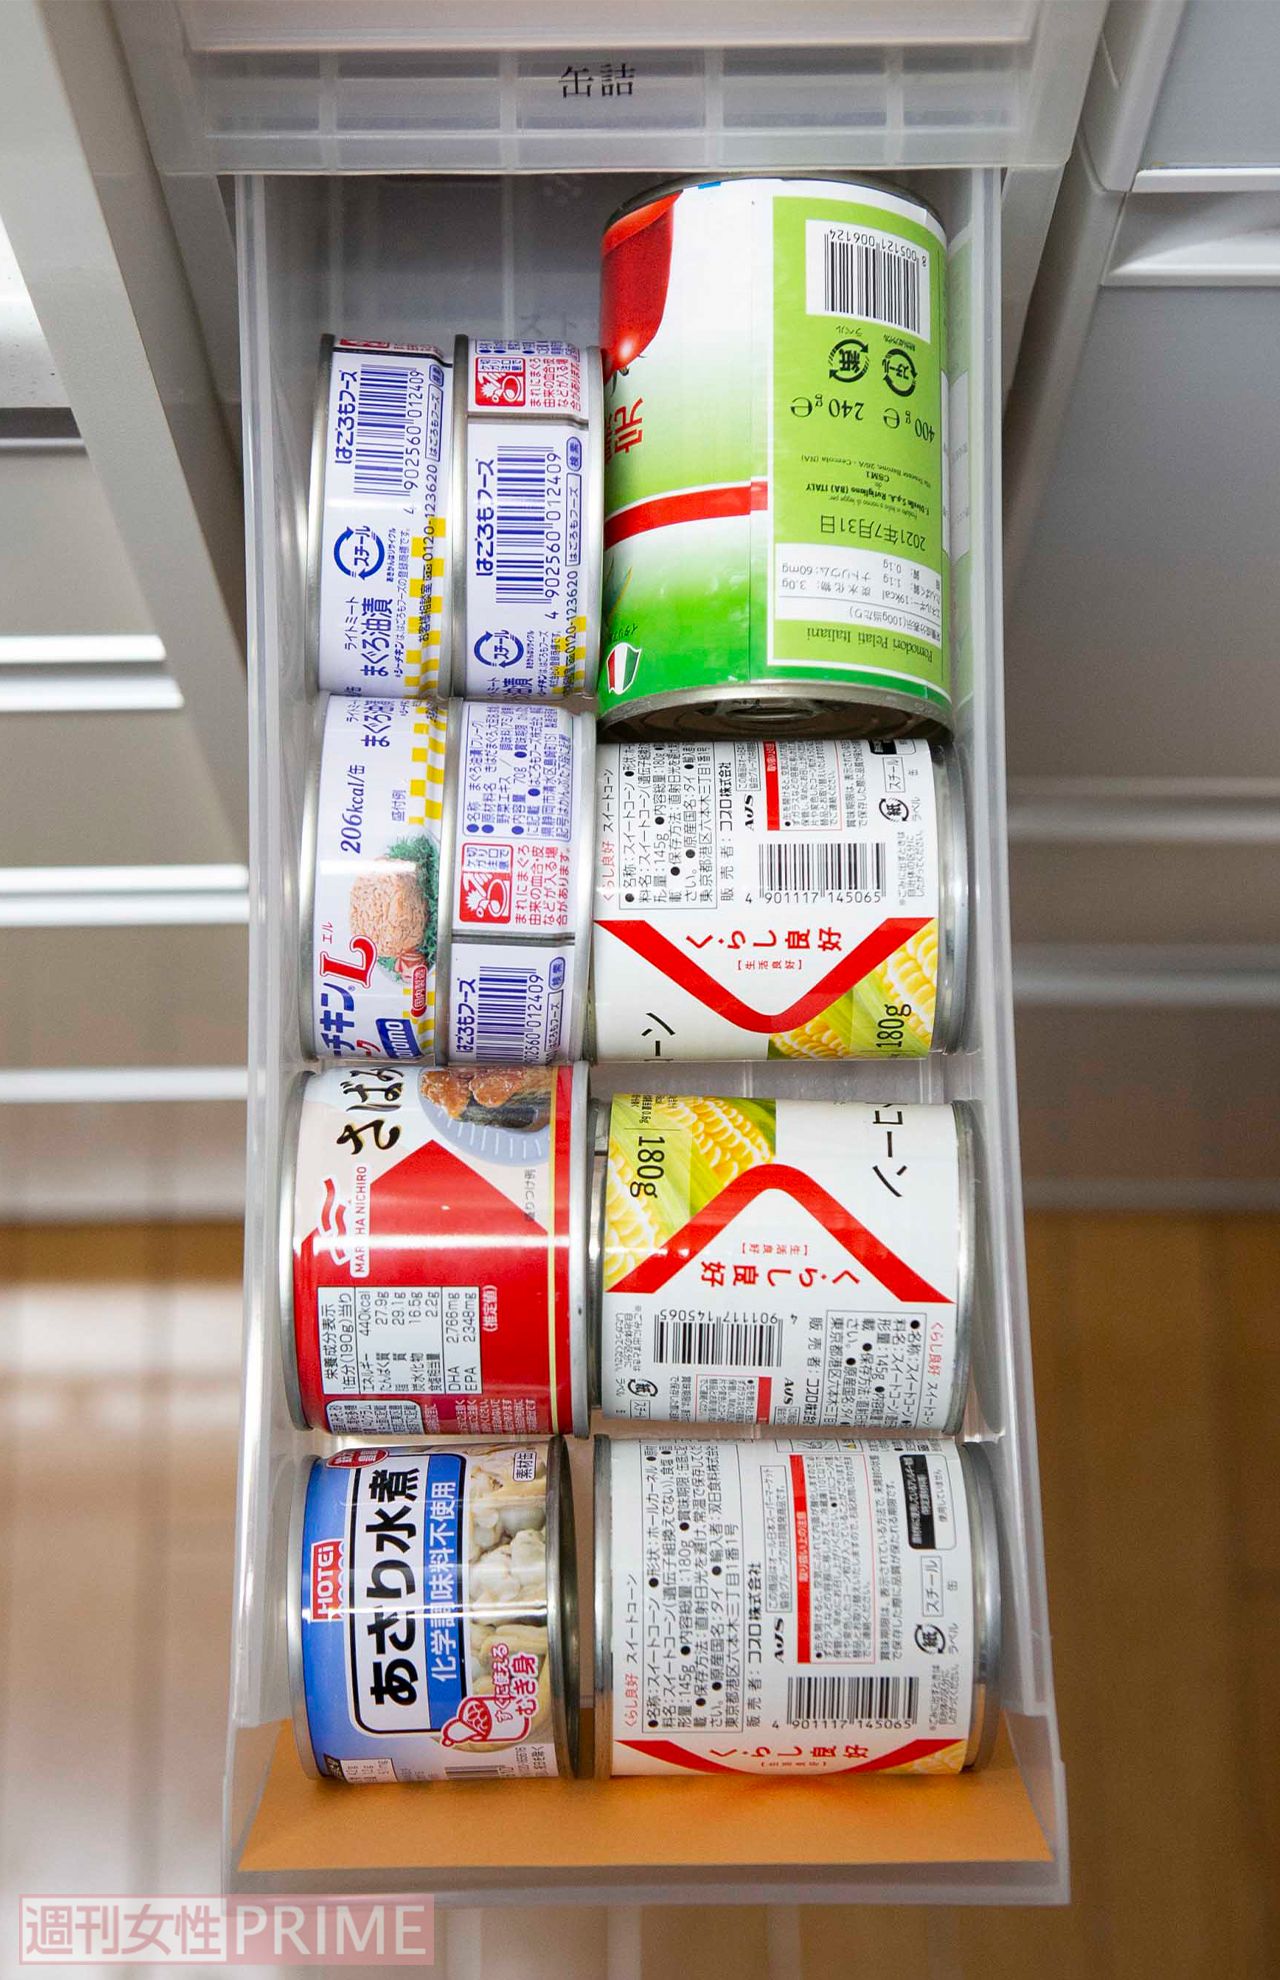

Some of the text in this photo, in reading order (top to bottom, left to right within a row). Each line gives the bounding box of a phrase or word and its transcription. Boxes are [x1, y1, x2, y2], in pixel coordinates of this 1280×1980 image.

[550, 63, 594, 81] 缶詰
[829, 229, 875, 246] 006124
[881, 239, 917, 261] 005121
[836, 325, 862, 336] ラベル
[838, 348, 861, 374] 紙
[881, 359, 909, 380] スチール
[407, 370, 424, 418] 012409
[828, 398, 864, 421] 240
[334, 370, 357, 464] はごろもフーズ
[429, 394, 440, 456] はごろもフーズ
[915, 418, 935, 443] 400
[404, 426, 421, 490] 902560
[422, 463, 439, 562] 0120-123620
[475, 458, 495, 576] はごろもフーズ
[354, 526, 371, 566] スチール
[545, 453, 562, 619] 4 902560 012409
[820, 515, 926, 551] 2021年7月31日
[782, 580, 805, 590] 3.0g
[345, 596, 359, 650] ライトミート
[564, 570, 578, 653] 0120-123620
[360, 597, 393, 677] まぐろ油漬
[493, 629, 510, 659] スチール
[807, 628, 933, 663] Pomodori Pelati Italiani
[887, 759, 902, 790] スチール
[340, 764, 365, 854] 206kcal/缶
[391, 789, 406, 822] 盛付例
[744, 794, 754, 833] AJS
[887, 803, 902, 817] 紙
[911, 796, 922, 821] ラベル
[601, 768, 615, 901] くらし良好 スイートコーン
[515, 845, 529, 925] まれにまぐろ
[543, 846, 557, 925] などが入る場
[556, 847, 570, 926] 合があります。
[685, 868, 697, 902] さい。
[745, 890, 881, 904] 4 901117 145065
[322, 922, 333, 944] エル
[685, 927, 843, 953] くらし良好
[456, 978, 476, 1053] はごろもフーズ
[527, 975, 544, 1028] 012409
[876, 1003, 912, 1049] 180g
[629, 1135, 665, 1199] 180g
[356, 1166, 367, 1214] NICHIRO
[524, 1169, 536, 1221] 盛りつけ例
[699, 1261, 860, 1289] くらし良好
[391, 1291, 406, 1326] 29.1g
[425, 1291, 440, 1317] 2.2g
[482, 1285, 498, 1332] (推定値)
[659, 1309, 798, 1324] 4 901117 145065
[321, 1304, 338, 1379] 栄養成分表示
[338, 1293, 355, 1391] 1缶分(190g)当り
[358, 1291, 375, 1391] エネルギー 440kcal
[375, 1291, 391, 1391] たんぱく質 27.9g
[408, 1291, 425, 1391] 炭水化物 16.5g
[845, 1318, 859, 1349] さい。
[448, 1366, 461, 1391] DHA
[464, 1366, 477, 1391] EPA
[616, 1378, 624, 1397] ラベル
[784, 1378, 794, 1405] AJS
[923, 1322, 943, 1426] くらし良好 スイートコーン
[516, 1452, 534, 1479] 素材缶
[364, 1467, 421, 1706] あさり水煮
[428, 1481, 458, 1682] 化学調味料不使用
[927, 1560, 940, 1613] スチール
[625, 1574, 639, 1728] くらし良好 スイートコーン
[774, 1617, 784, 1664] AJS
[922, 1631, 938, 1648] 紙
[948, 1623, 959, 1654] ラベル
[492, 1643, 513, 1722] すぐに使える
[511, 1653, 537, 1717] むき身
[710, 1700, 723, 1728] さい。
[771, 1719, 911, 1730] 4 901117 145065
[709, 1744, 869, 1760] くらし良好
